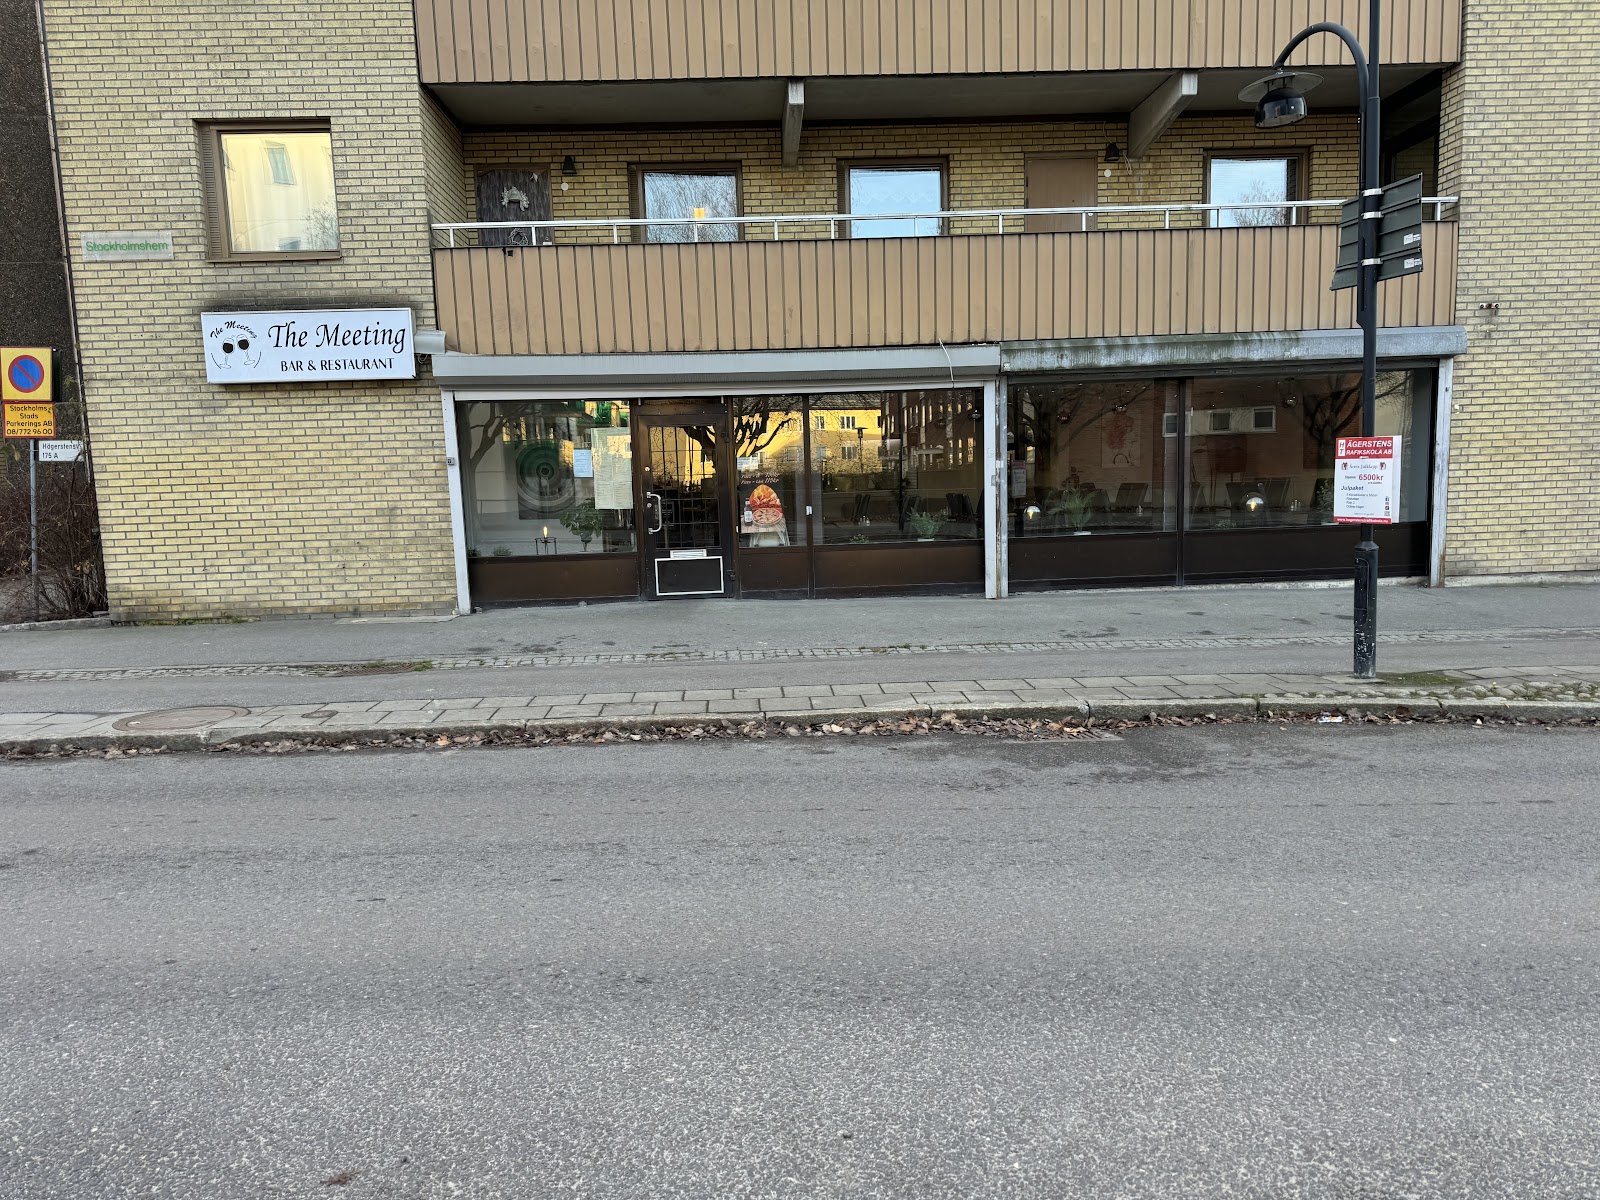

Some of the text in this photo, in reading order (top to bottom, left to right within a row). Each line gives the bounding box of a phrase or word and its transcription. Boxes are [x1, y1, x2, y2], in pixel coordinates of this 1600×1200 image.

[85, 240, 168, 252] Stockholmshem
[210, 327, 224, 338] The
[267, 321, 406, 354] The Meeting
[281, 358, 395, 372] BAR & RESTAURANT
